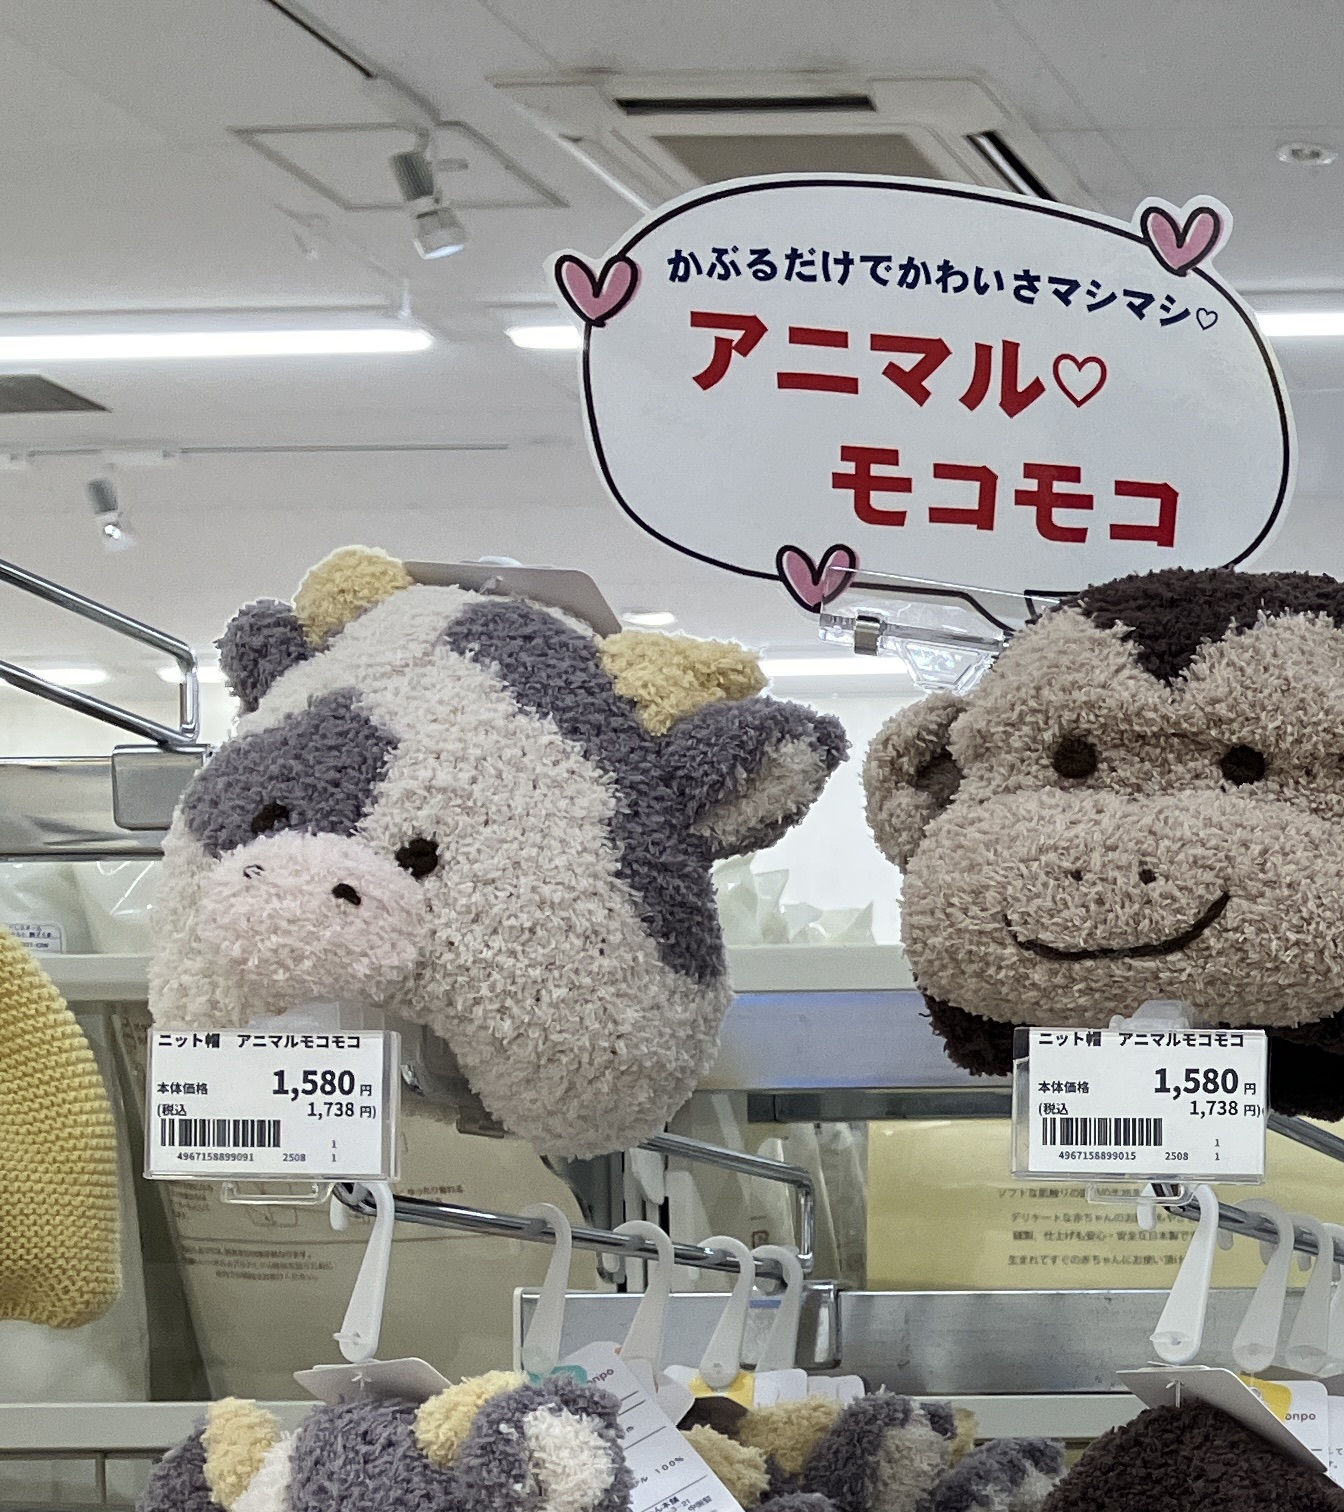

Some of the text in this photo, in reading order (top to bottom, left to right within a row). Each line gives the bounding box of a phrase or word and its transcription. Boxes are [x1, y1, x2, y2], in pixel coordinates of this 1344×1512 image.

[666, 247, 1192, 328] かぶるだけでかわいさマシマシ
[690, 309, 1046, 419] アニマル
[832, 445, 1179, 548] モコモコ
[159, 1034, 361, 1049] ニット帽 アニマルモコモコ
[1039, 1032, 1244, 1047] ニット帽 アニマルモコモコ
[157, 1082, 208, 1095] 本体価格
[1038, 1081, 1089, 1094] 本体価格
[177, 1153, 254, 1161] 4967158899091
[283, 1154, 306, 1162] 2508
[1059, 1151, 1136, 1160] 4967158899015
[1165, 1152, 1189, 1161] 2508
